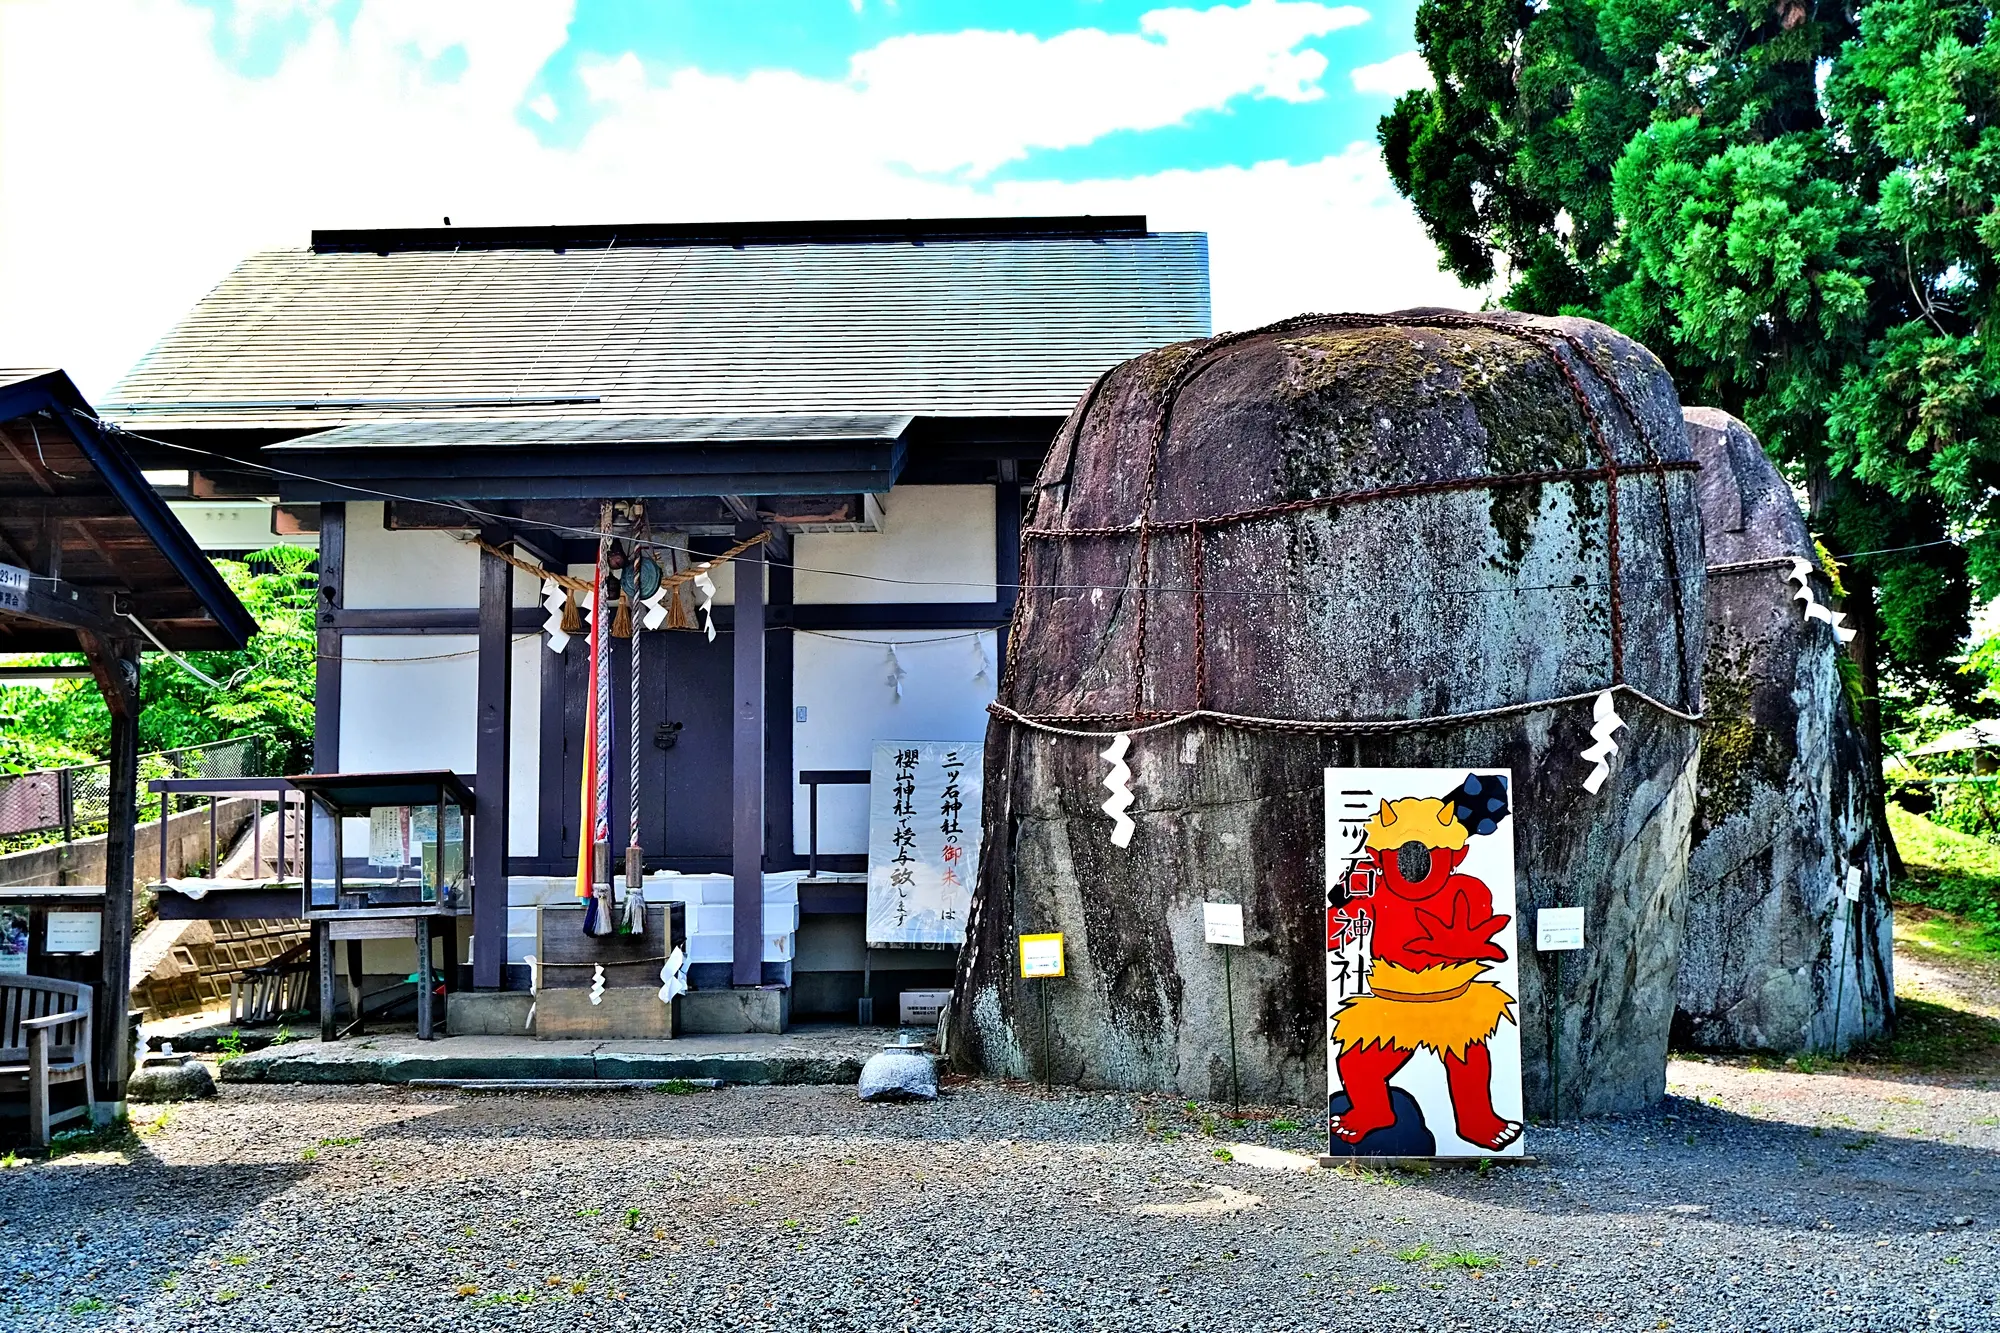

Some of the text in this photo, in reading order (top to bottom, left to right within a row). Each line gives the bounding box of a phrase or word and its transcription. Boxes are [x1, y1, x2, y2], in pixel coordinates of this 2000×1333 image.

[891, 749, 919, 927] 櫻山神社で授与致します
[940, 751, 964, 920] 三ツ石神社の御朱印は
[1331, 790, 1375, 998] 三ツ石神社
